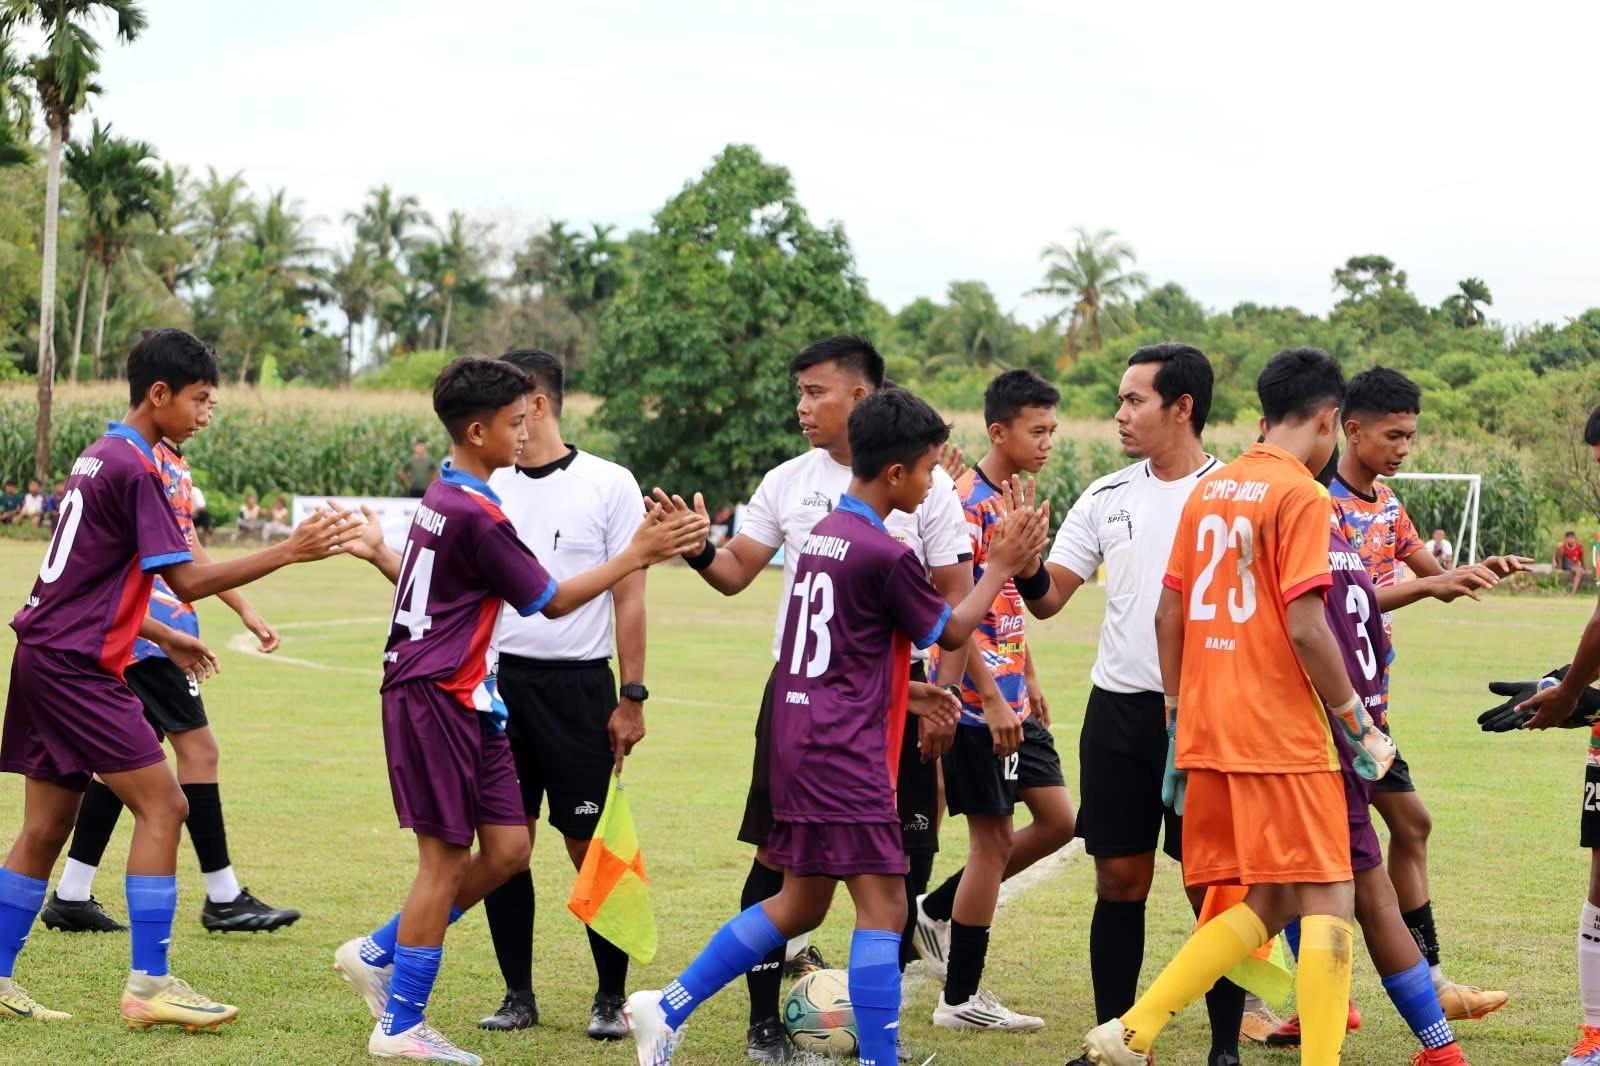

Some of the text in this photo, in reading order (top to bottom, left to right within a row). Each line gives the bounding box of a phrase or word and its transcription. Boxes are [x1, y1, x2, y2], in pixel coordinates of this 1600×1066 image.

[1107, 514, 1131, 524] SPECS
[387, 538, 436, 642] 14
[1189, 513, 1257, 624] 23
[790, 571, 834, 678] 13
[1345, 584, 1378, 681] 3
[575, 807, 600, 816] SPECS
[1004, 751, 1019, 780] 12
